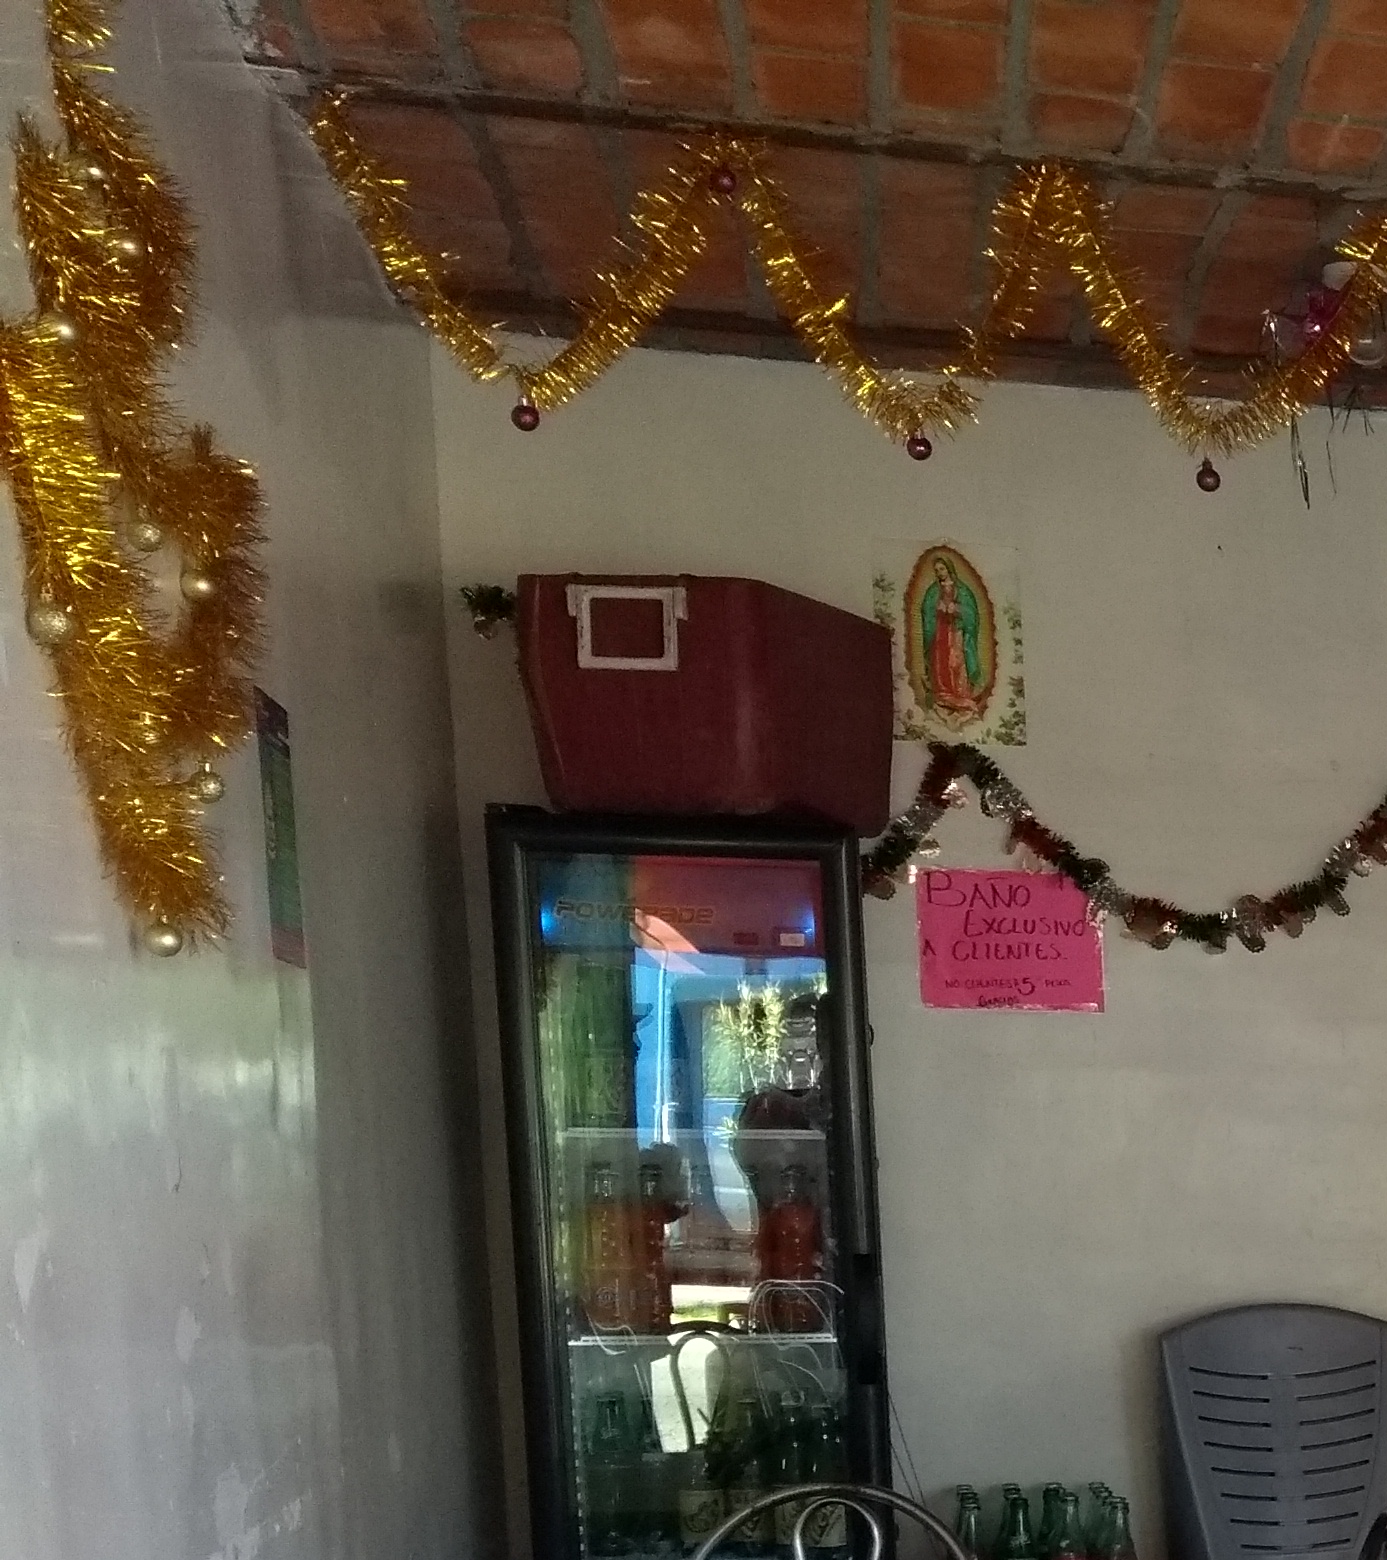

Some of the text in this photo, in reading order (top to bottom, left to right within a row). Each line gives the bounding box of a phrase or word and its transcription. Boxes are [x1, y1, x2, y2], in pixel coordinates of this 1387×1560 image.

[924, 870, 1031, 909] BAÑO
[964, 909, 1086, 938] EXCLUSIVO
[921, 938, 937, 957] A
